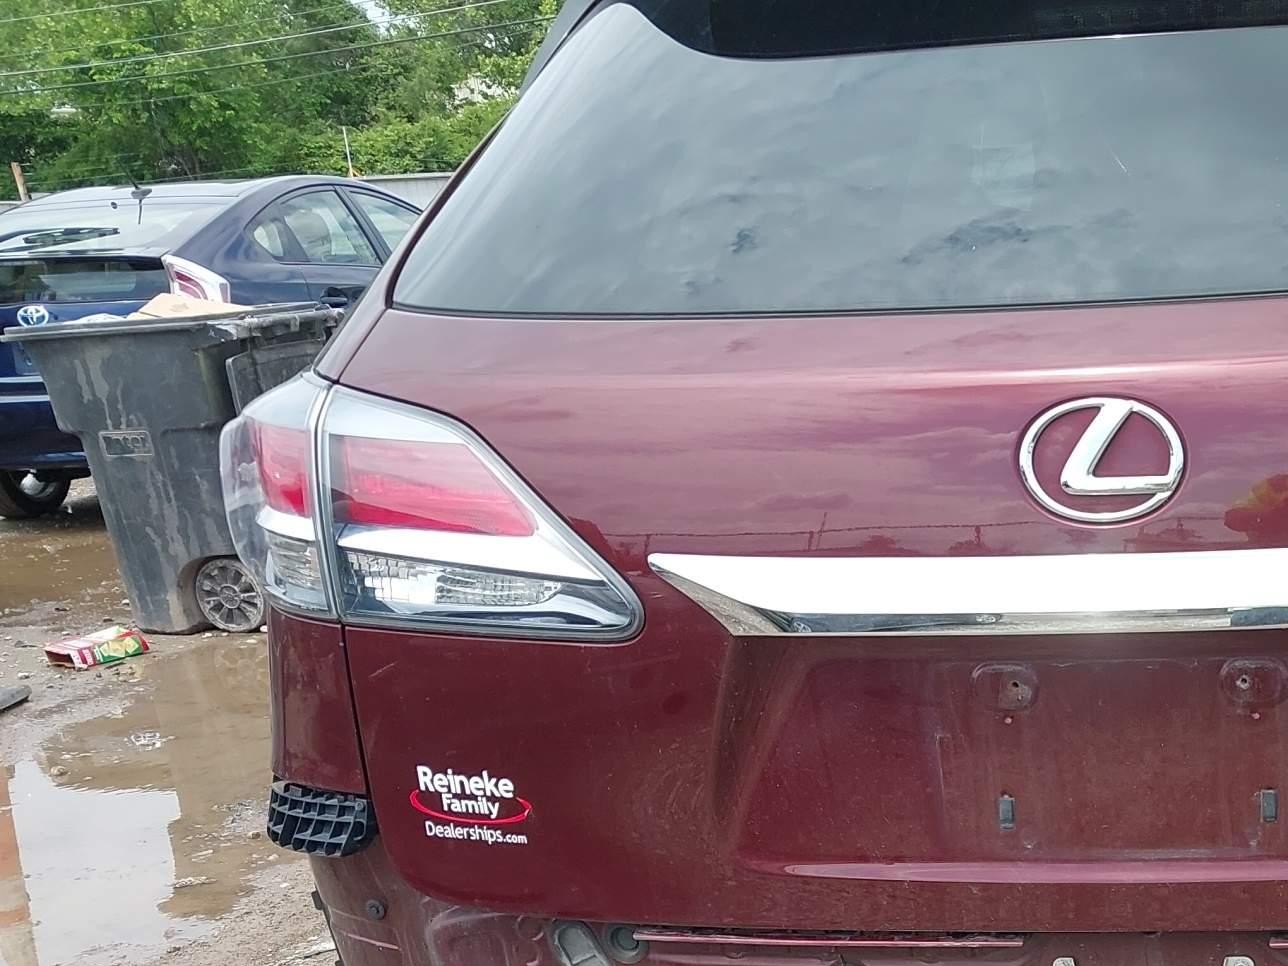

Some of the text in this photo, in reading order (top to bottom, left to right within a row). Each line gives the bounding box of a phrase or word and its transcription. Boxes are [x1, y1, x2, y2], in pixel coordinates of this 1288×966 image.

[416, 765, 514, 798] Reineke
[441, 793, 500, 819] Family
[425, 821, 528, 845] Dealerships.com
